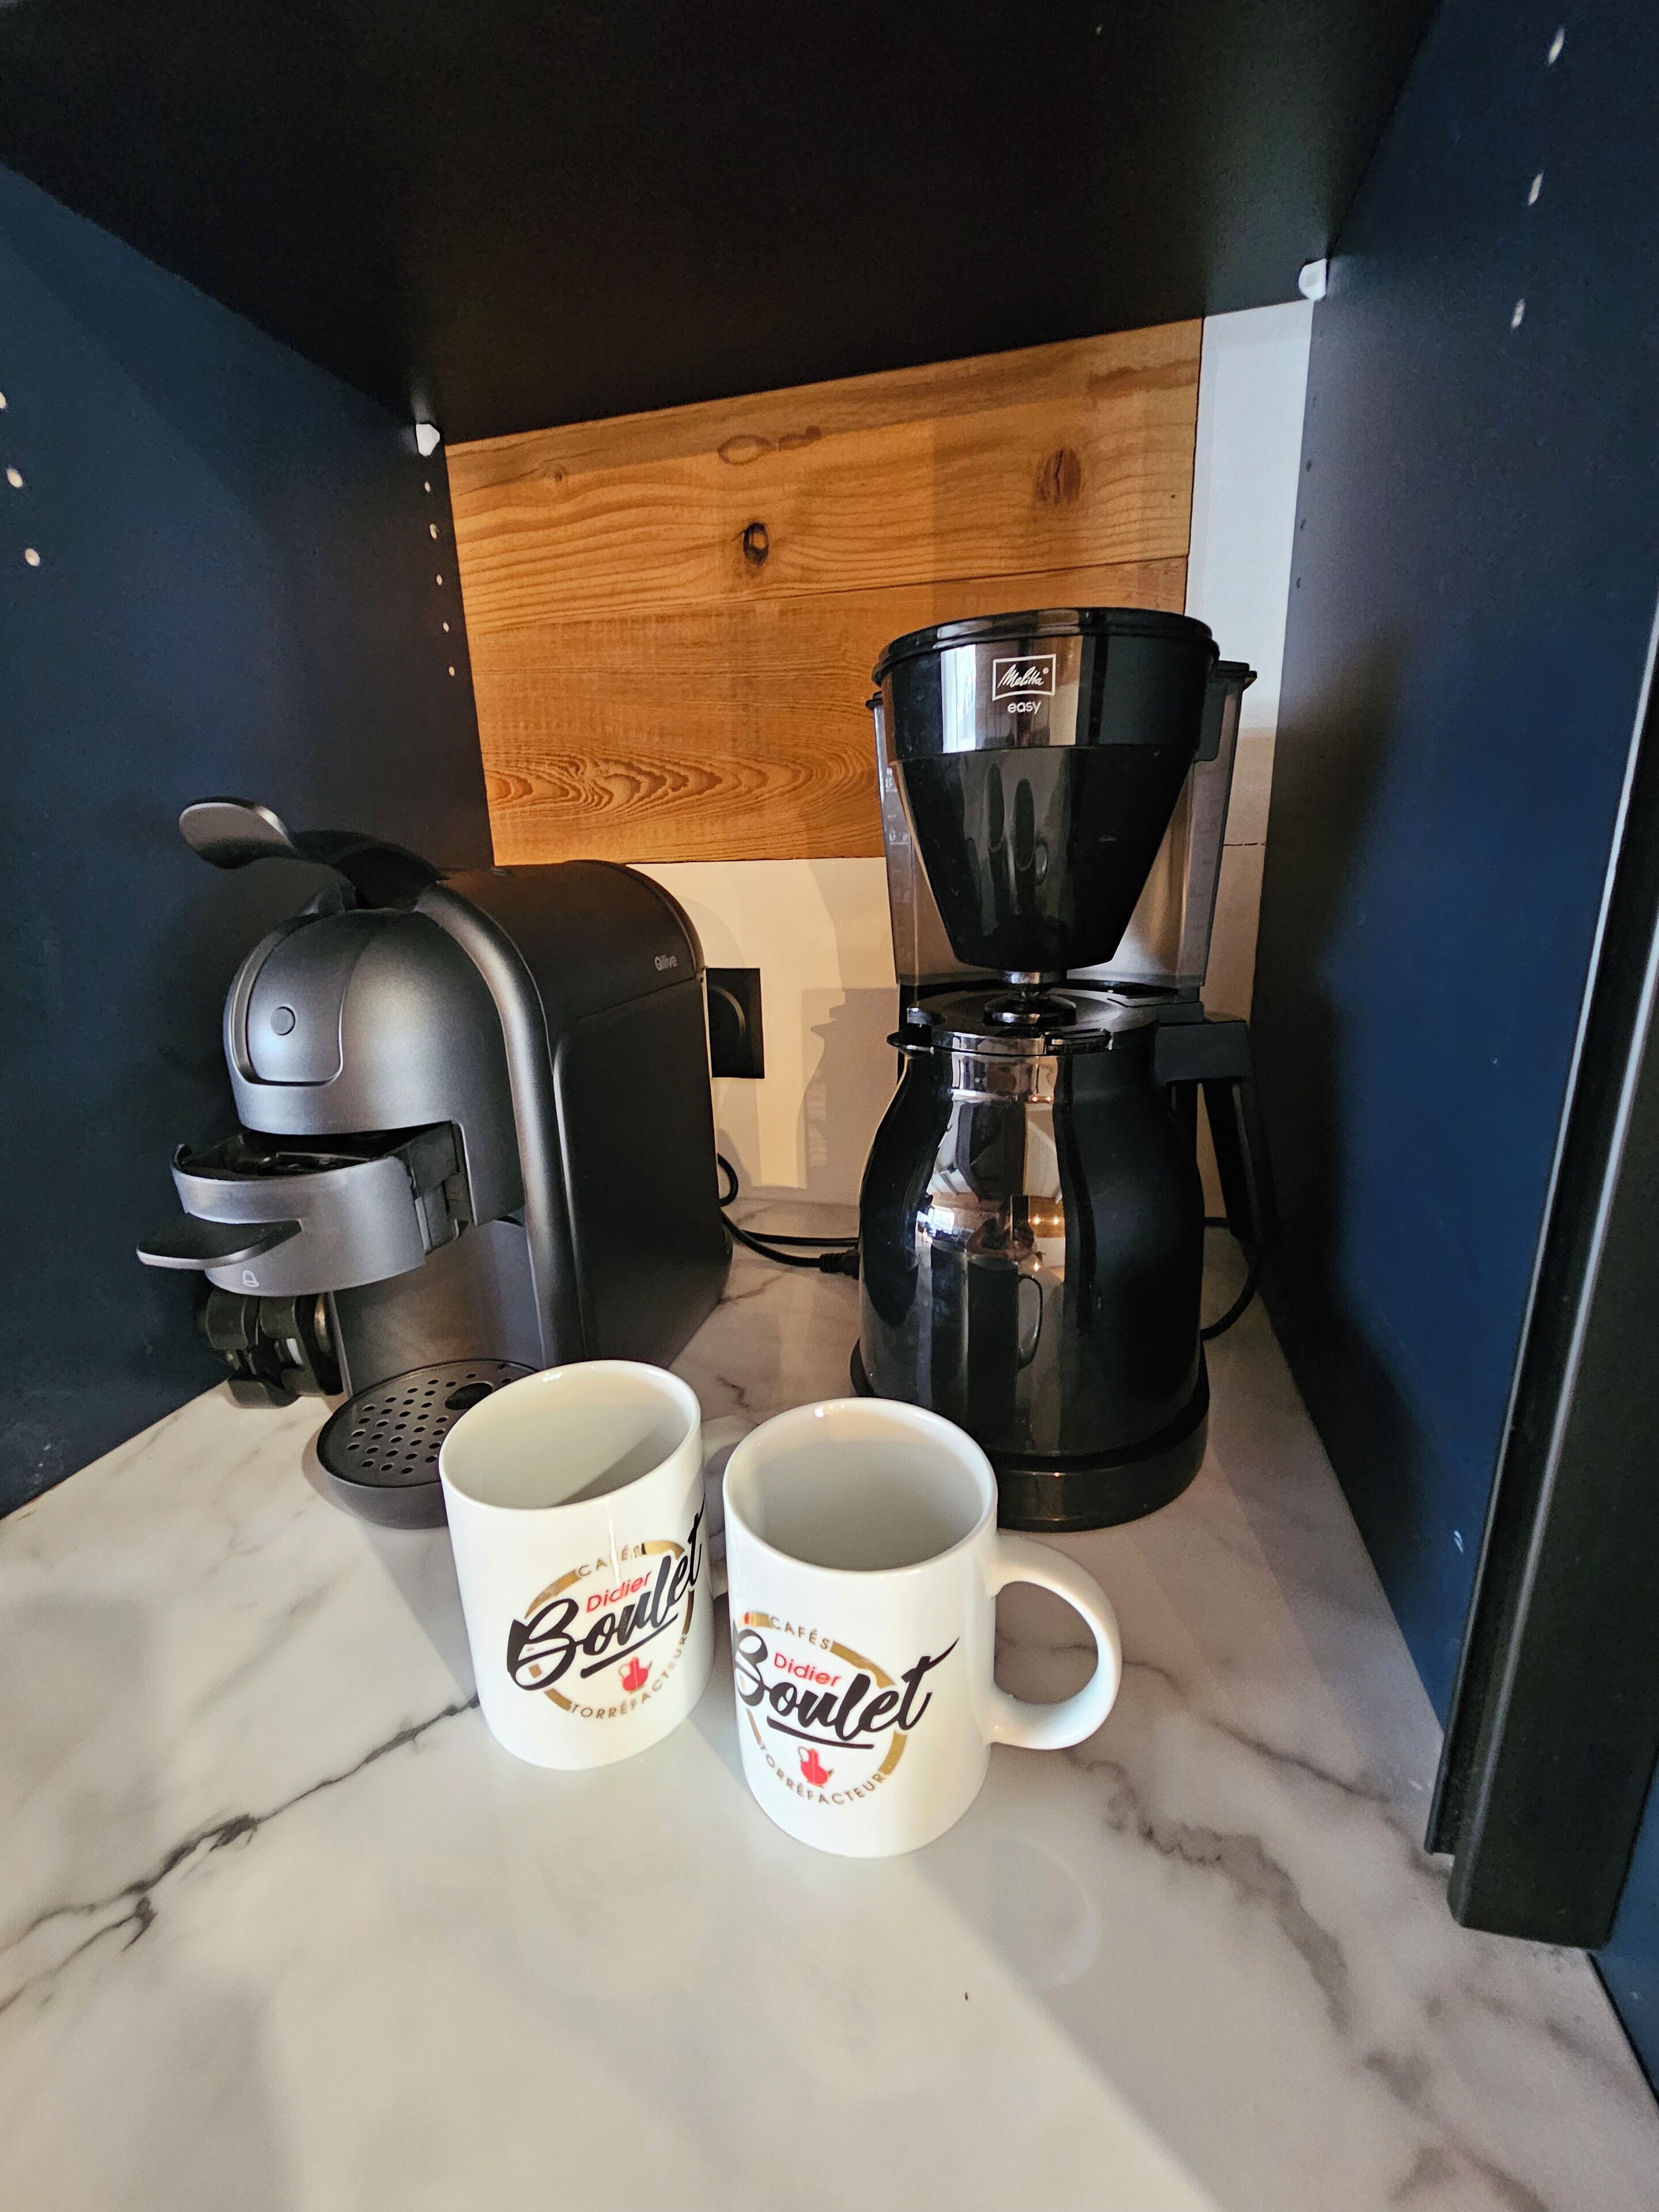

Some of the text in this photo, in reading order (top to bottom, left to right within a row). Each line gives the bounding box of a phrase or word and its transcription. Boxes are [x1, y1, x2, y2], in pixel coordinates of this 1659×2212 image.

[997, 664, 1044, 688] Melitta
[1007, 700, 1042, 714] easy
[506, 1492, 706, 1691] Boulet
[586, 1570, 652, 1613] Didier
[769, 1616, 831, 1651] CAFÉS
[733, 1618, 960, 1741] Boulet
[772, 1652, 842, 1688] Didier
